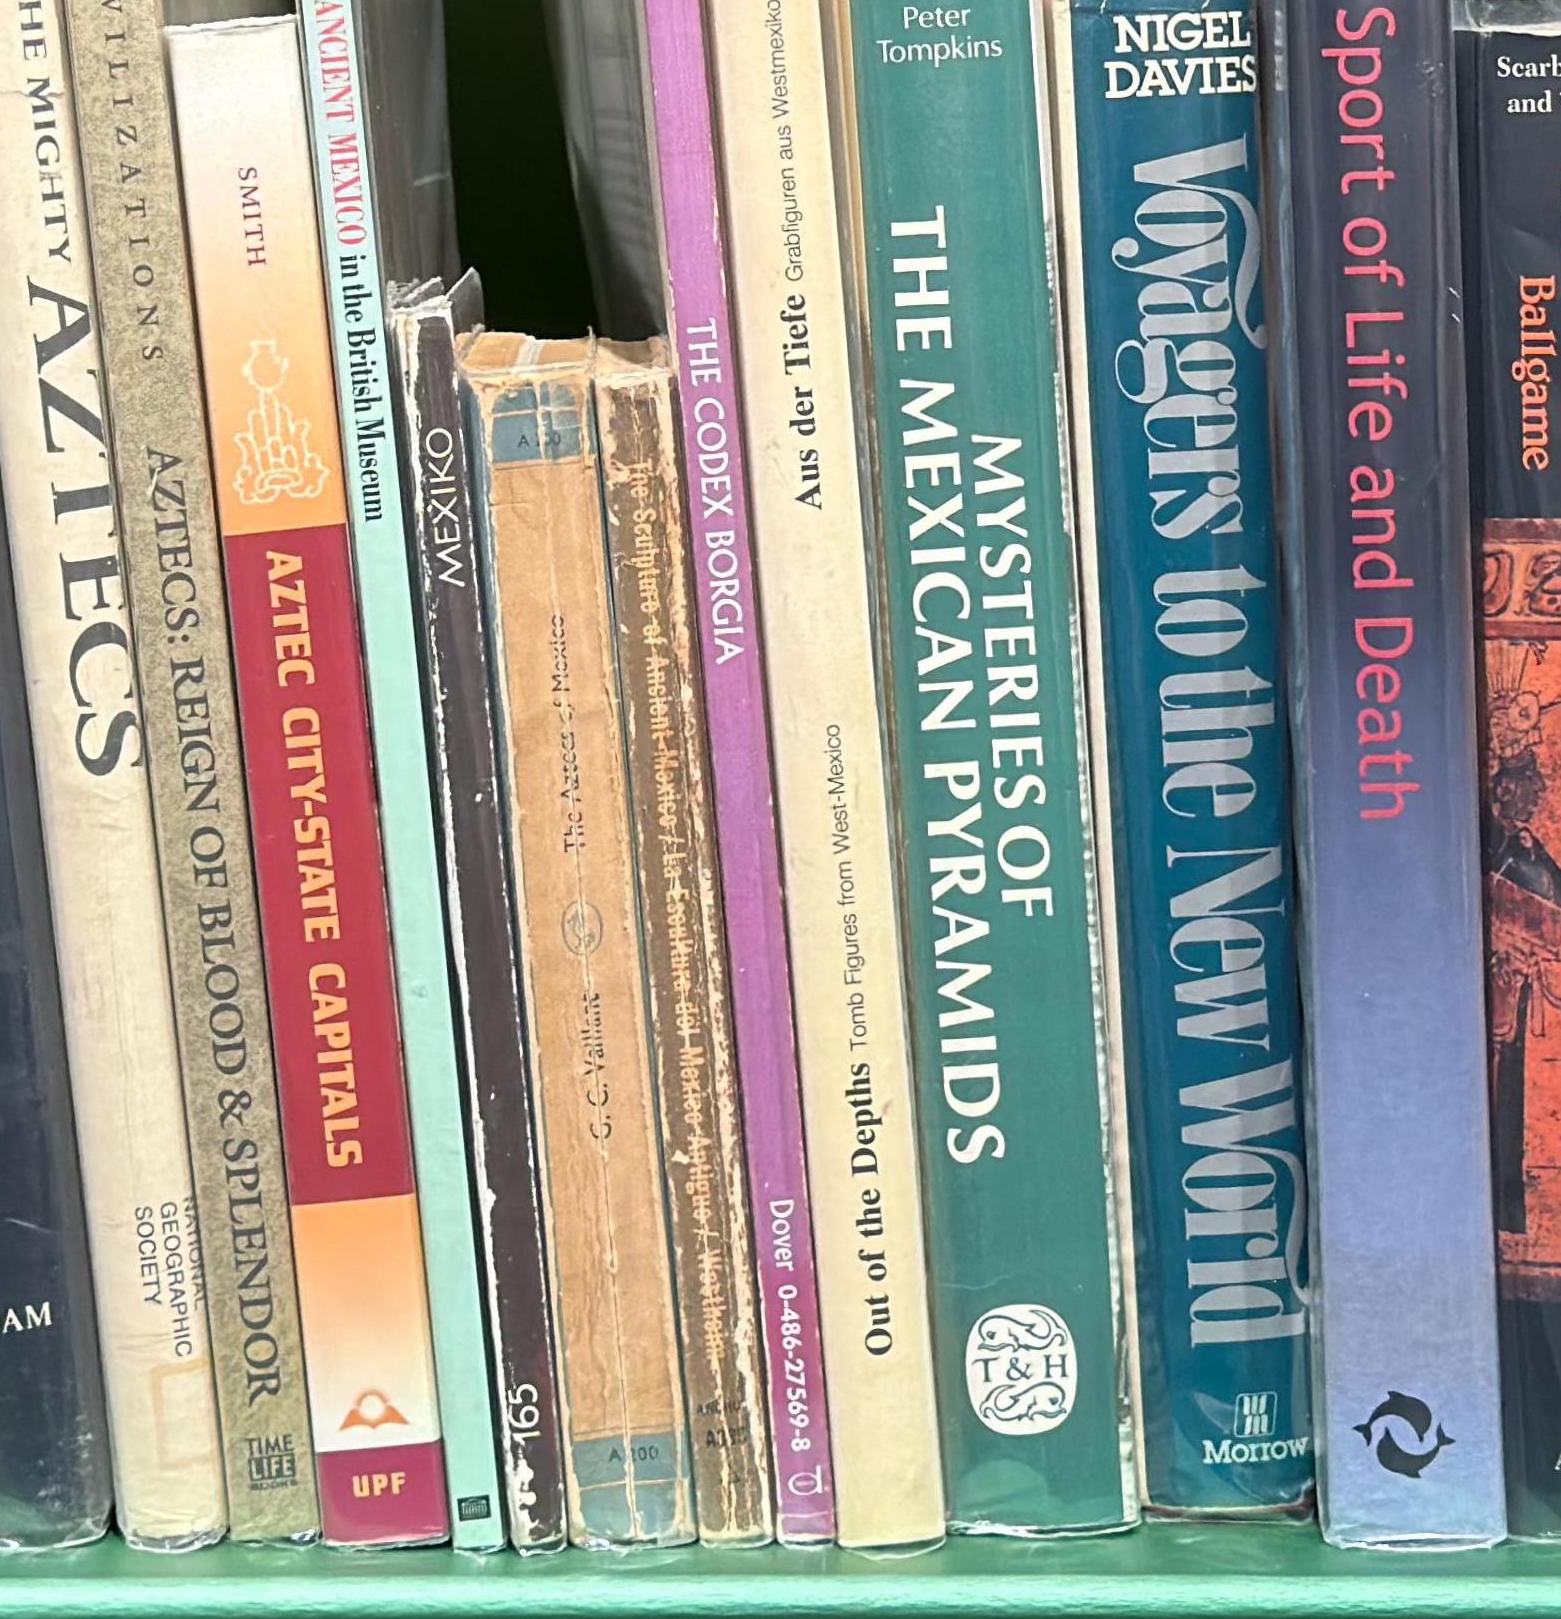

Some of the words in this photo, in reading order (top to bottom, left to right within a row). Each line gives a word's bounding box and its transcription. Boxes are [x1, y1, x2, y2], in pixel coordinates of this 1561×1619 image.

[766, 0, 790, 119] Westmexiko
[877, 37, 1003, 67] Tompkins
[903, 6, 970, 29] Peter
[1113, 11, 1251, 53] NIGEL
[1105, 57, 1257, 99] DAVIES
[1321, 6, 1397, 194] Sport
[1507, 91, 1551, 113] and
[779, 125, 792, 160] aus
[238, 166, 266, 267] SMITH
[327, 132, 367, 246] MEXICO
[780, 168, 803, 281] Grabfiguren
[338, 255, 358, 276] in
[890, 206, 952, 352] THE
[1342, 217, 1404, 286] of
[340, 280, 363, 323] the
[780, 295, 811, 375] Tiefe
[340, 326, 376, 415] British
[686, 318, 721, 386] THE
[1346, 311, 1408, 442] Life
[1512, 275, 1555, 471] Ballgame
[789, 387, 815, 436] der
[355, 418, 386, 522] Museum
[693, 397, 734, 519] CODEX
[795, 446, 821, 509] Aus
[425, 427, 465, 587] MEXIKO
[1348, 467, 1414, 588] and
[705, 530, 745, 664] BORGIA
[898, 379, 977, 732] MEXICAN
[266, 551, 315, 688] AZTEC
[971, 434, 1046, 808] MYSTERIES
[1354, 617, 1421, 820] Death
[282, 706, 341, 942] CITY-STATE
[823, 724, 849, 855] West-Mexico
[838, 860, 854, 909] from
[997, 825, 1054, 917] OF
[844, 914, 866, 985] Figures
[924, 761, 1005, 1164] PYRAMIDS
[309, 962, 364, 1169] CAPITALS
[850, 993, 868, 1052] Tomb
[769, 1199, 794, 1271] Dover
[778, 1285, 810, 1451] 0-486-27569-8
[245, 1433, 295, 1456] TIME
[250, 1455, 294, 1479] LIFE
[352, 1472, 406, 1497] UPF
[1202, 1436, 1308, 1465] Morrow
